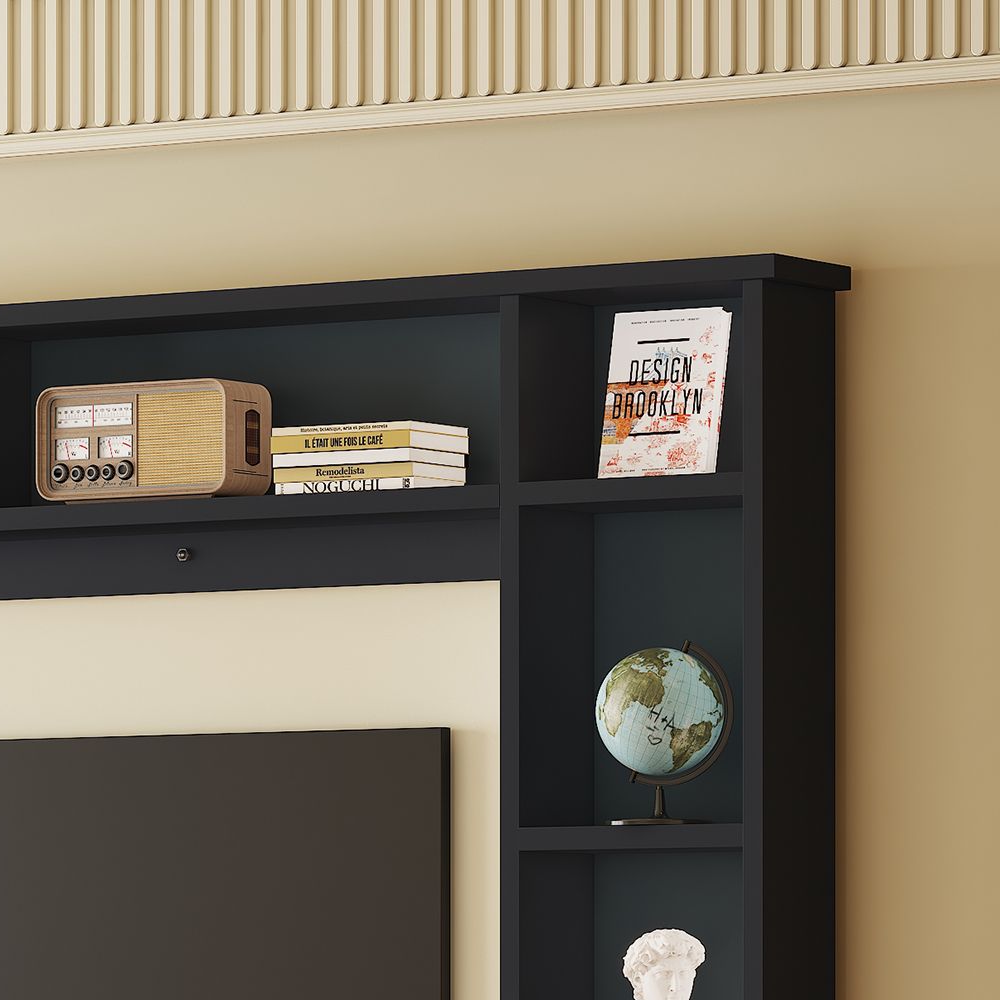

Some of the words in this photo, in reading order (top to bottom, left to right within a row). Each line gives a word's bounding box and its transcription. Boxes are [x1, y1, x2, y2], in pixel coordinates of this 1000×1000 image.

[628, 356, 693, 386] DESIGN
[612, 388, 703, 419] BROOKLYN
[304, 439, 311, 448] IL
[312, 437, 329, 448] ÉTAIT
[330, 438, 343, 448] UNE
[343, 436, 358, 447] FOIS
[358, 436, 367, 446] LE
[367, 433, 384, 445] CAFÉ
[315, 467, 365, 477] Remodelista
[303, 478, 380, 494] NOGUCHI
